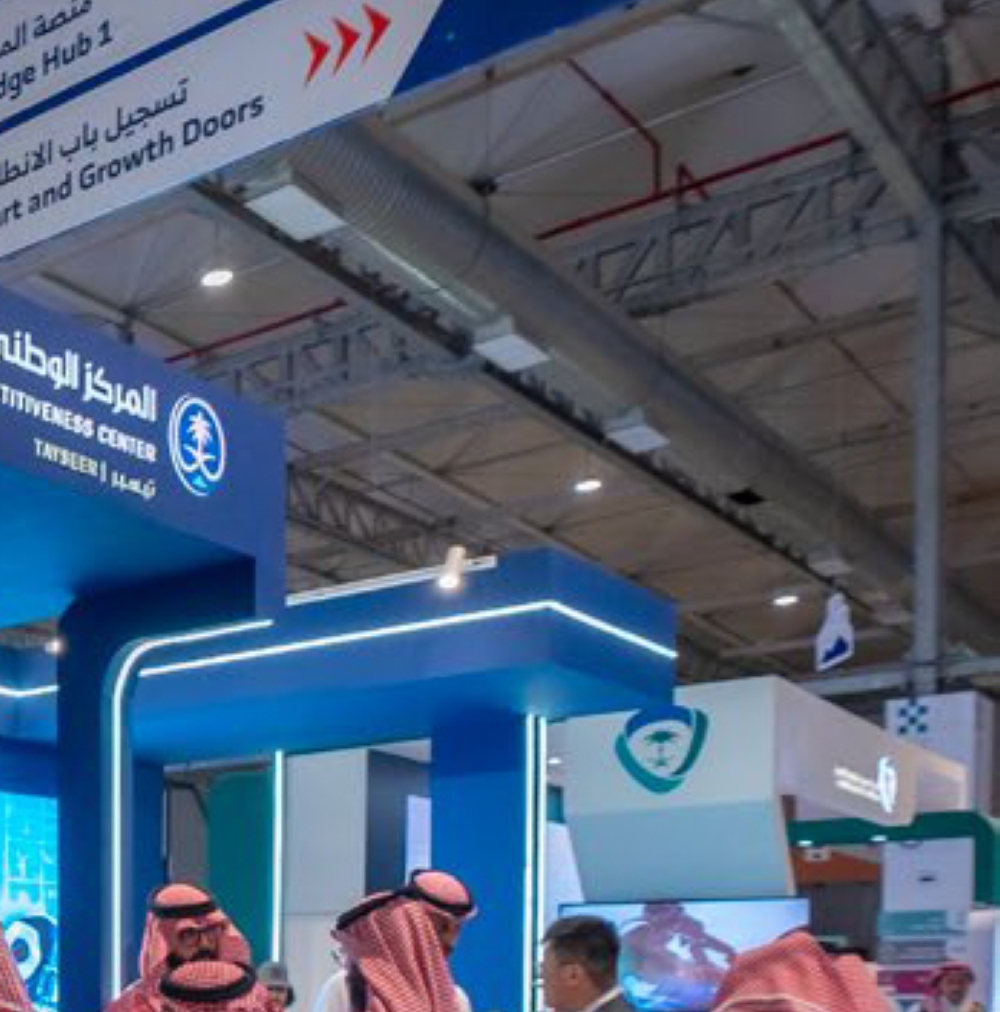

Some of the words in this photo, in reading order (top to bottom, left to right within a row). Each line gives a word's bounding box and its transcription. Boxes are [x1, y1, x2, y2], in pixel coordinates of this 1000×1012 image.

[42, 32, 92, 76] Hub
[97, 19, 113, 47] 1
[105, 79, 188, 143] تسجيل
[27, 174, 73, 213] and
[79, 128, 175, 193] Growth
[182, 95, 265, 147] Doors
[59, 122, 99, 162] باب
[82, 360, 158, 422] المركز
[34, 437, 98, 476] TAYSEER
[97, 423, 158, 463] CENTER
